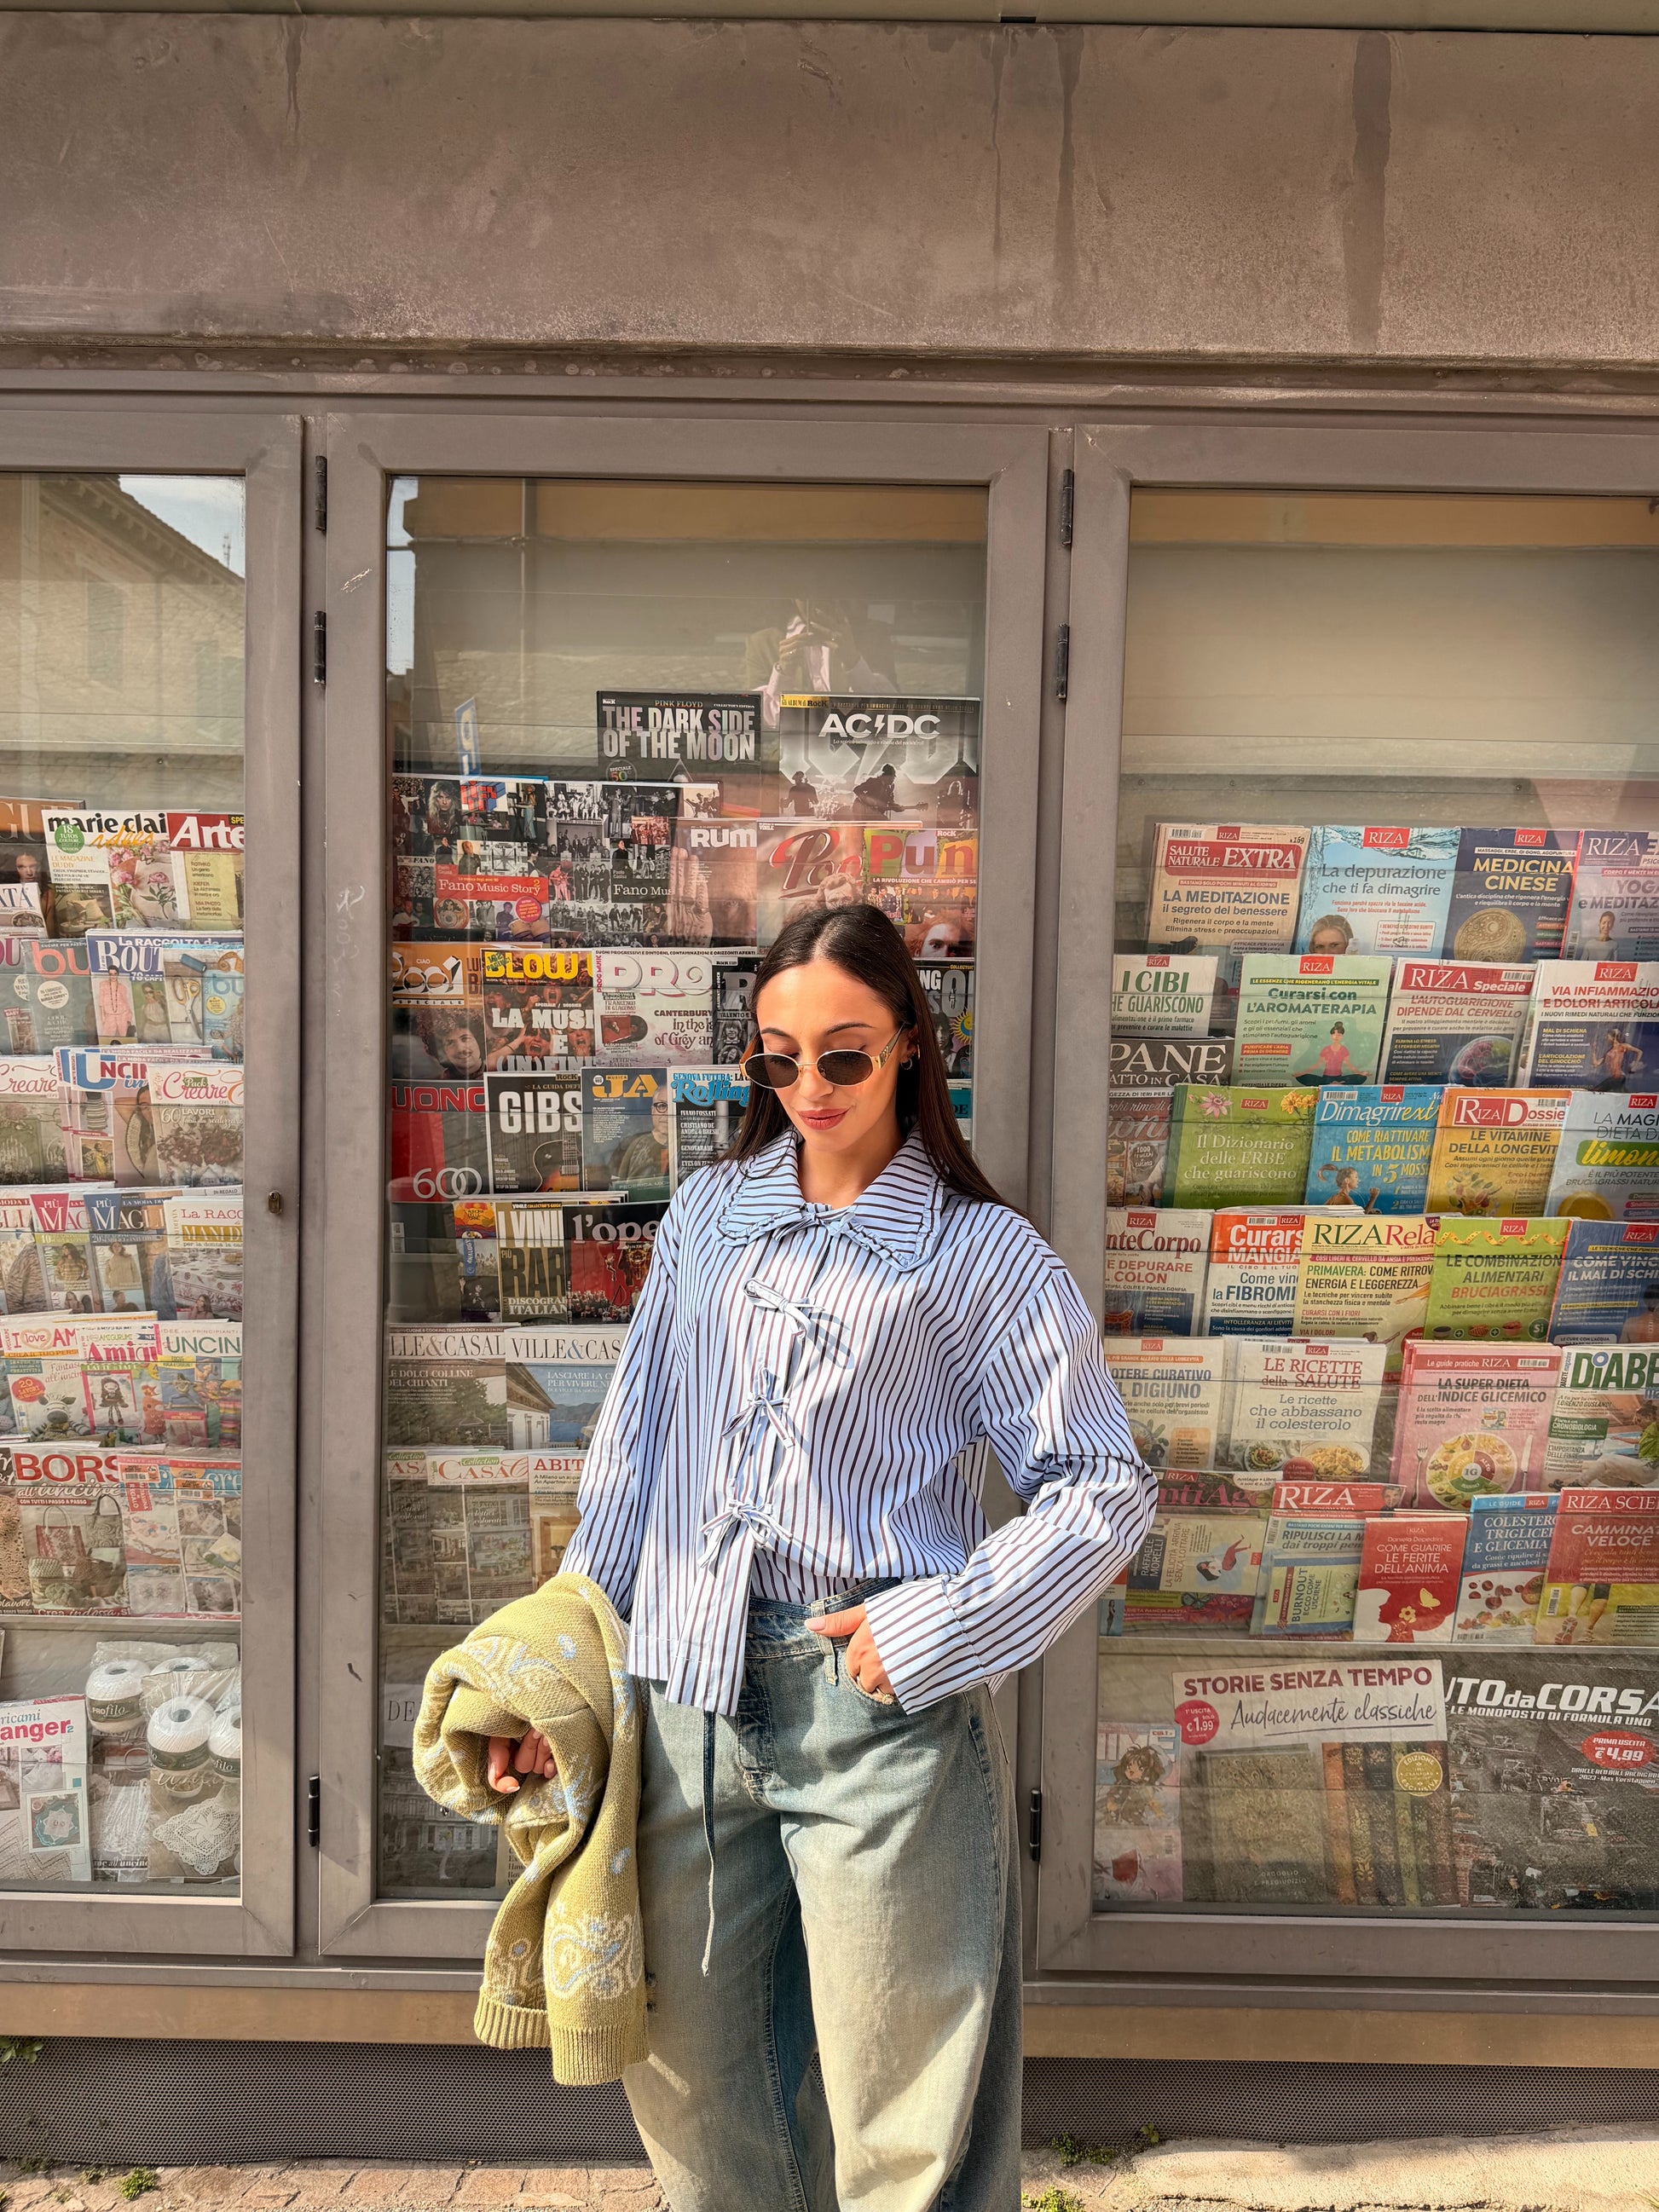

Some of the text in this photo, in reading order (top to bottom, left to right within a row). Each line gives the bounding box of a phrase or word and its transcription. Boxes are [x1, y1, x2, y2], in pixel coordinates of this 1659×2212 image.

[603, 707, 755, 731] THE DARK SIDE
[604, 731, 755, 762] OF THE MOON
[49, 813, 118, 834] marie
[62, 824, 74, 834] 18
[1368, 832, 1405, 845] RIZA
[1517, 834, 1542, 844] RIZA
[1170, 846, 1209, 857] SALUTE
[1586, 838, 1640, 857] RIZA
[1168, 857, 1221, 867] NATURALE
[1223, 847, 1296, 869] EXTRA
[1321, 863, 1447, 881] La depurazione
[1473, 858, 1575, 874] MEDICINA
[439, 880, 540, 895] Fano Music Story
[614, 884, 648, 895] Fano
[1485, 875, 1558, 892] CINESE
[1322, 883, 1441, 898] che ti fa dimagrire
[1163, 890, 1290, 905] LA MEDITAZIONE
[1171, 904, 1211, 915] segreto
[1214, 906, 1230, 915] del
[1233, 905, 1288, 916] benessere
[485, 952, 578, 979] BLOW
[1302, 962, 1331, 972] RIZA
[1121, 970, 1190, 993] I CIBI
[1409, 967, 1526, 994] RIZA Speciale
[1268, 987, 1357, 1001] Curarsi con
[1127, 996, 1204, 1014] GUARISCONO
[1246, 1002, 1377, 1014] L'AROMATERAPIA
[1410, 995, 1514, 1008] L'AUTOGUARIGIONE
[1554, 1000, 1602, 1009] DOLORI
[1396, 1008, 1523, 1019] DIPENDE DAL CERVELLO
[1110, 1042, 1228, 1074] PANE
[184, 1077, 208, 1088] Pack
[673, 1073, 699, 1082] GENOVA
[160, 1107, 181, 1123] 60
[1457, 1098, 1501, 1127] RIZA
[1196, 1135, 1295, 1150] Il Dizionario
[1374, 1130, 1431, 1143] RIATTIVARE
[1471, 1130, 1552, 1142] LE VITAMINE
[1449, 1143, 1490, 1154] DELLA
[1199, 1151, 1286, 1165] delle ERBE
[1184, 1168, 1298, 1181] che guariscono
[413, 1168, 482, 1199] 600
[1565, 1178, 1626, 1187] BRUCIAGRASSI
[43, 1197, 60, 1208] PIÙ
[96, 1196, 112, 1208] PIÙ
[1119, 1260, 1194, 1273] DEPURARE
[1306, 1265, 1398, 1277] PRIMAVERA: COME
[1114, 1271, 1167, 1284] COLON
[1240, 1272, 1275, 1285] Come
[1462, 1270, 1544, 1283] ALIMENTARI
[1305, 1278, 1419, 1290] ENERGIA E LEGGEREZZA
[1451, 1285, 1548, 1299] BRUCIAGRASSI
[23, 1333, 46, 1343] love
[1263, 1357, 1363, 1374] LE RICETTE
[1435, 1360, 1454, 1370] guide
[1456, 1360, 1480, 1369] pratiche
[1482, 1358, 1511, 1368] RIZA
[1153, 1369, 1211, 1381] CURATIVO
[1262, 1374, 1361, 1389] della SALUTE
[1131, 1382, 1201, 1399] DIGIUNO
[1437, 1378, 1529, 1390] LA SUPER DIETA
[1279, 1395, 1338, 1406] Le ricette
[1417, 1391, 1546, 1403] DELL'INDICE GLICEMICO
[1250, 1405, 1362, 1418] che abbassano
[1256, 1418, 1351, 1430] il colesterolo
[1279, 1484, 1356, 1512] RIZA
[1567, 1495, 1610, 1510] RIZA
[1282, 1530, 1336, 1541] RIPULISCI
[1587, 1535, 1651, 1547] VELOCE
[1377, 1544, 1453, 1552] COME GUARIRE
[1141, 1537, 1153, 1577] RAFFAELE
[1152, 1539, 1165, 1577] MORELLI
[1386, 1552, 1441, 1562] LE FERITE
[1374, 1562, 1448, 1574] DELL'ANIMA
[1291, 1568, 1309, 1623] BURNOUT
[1184, 1666, 1432, 1696] STORIE SENZA TEMPO
[1230, 1692, 1437, 1730] Audacemente classiche
[1450, 1706, 1652, 1727] LE MONOPOSTO DI FORMULA UNO
[1618, 1739, 1646, 1747] USCITA
